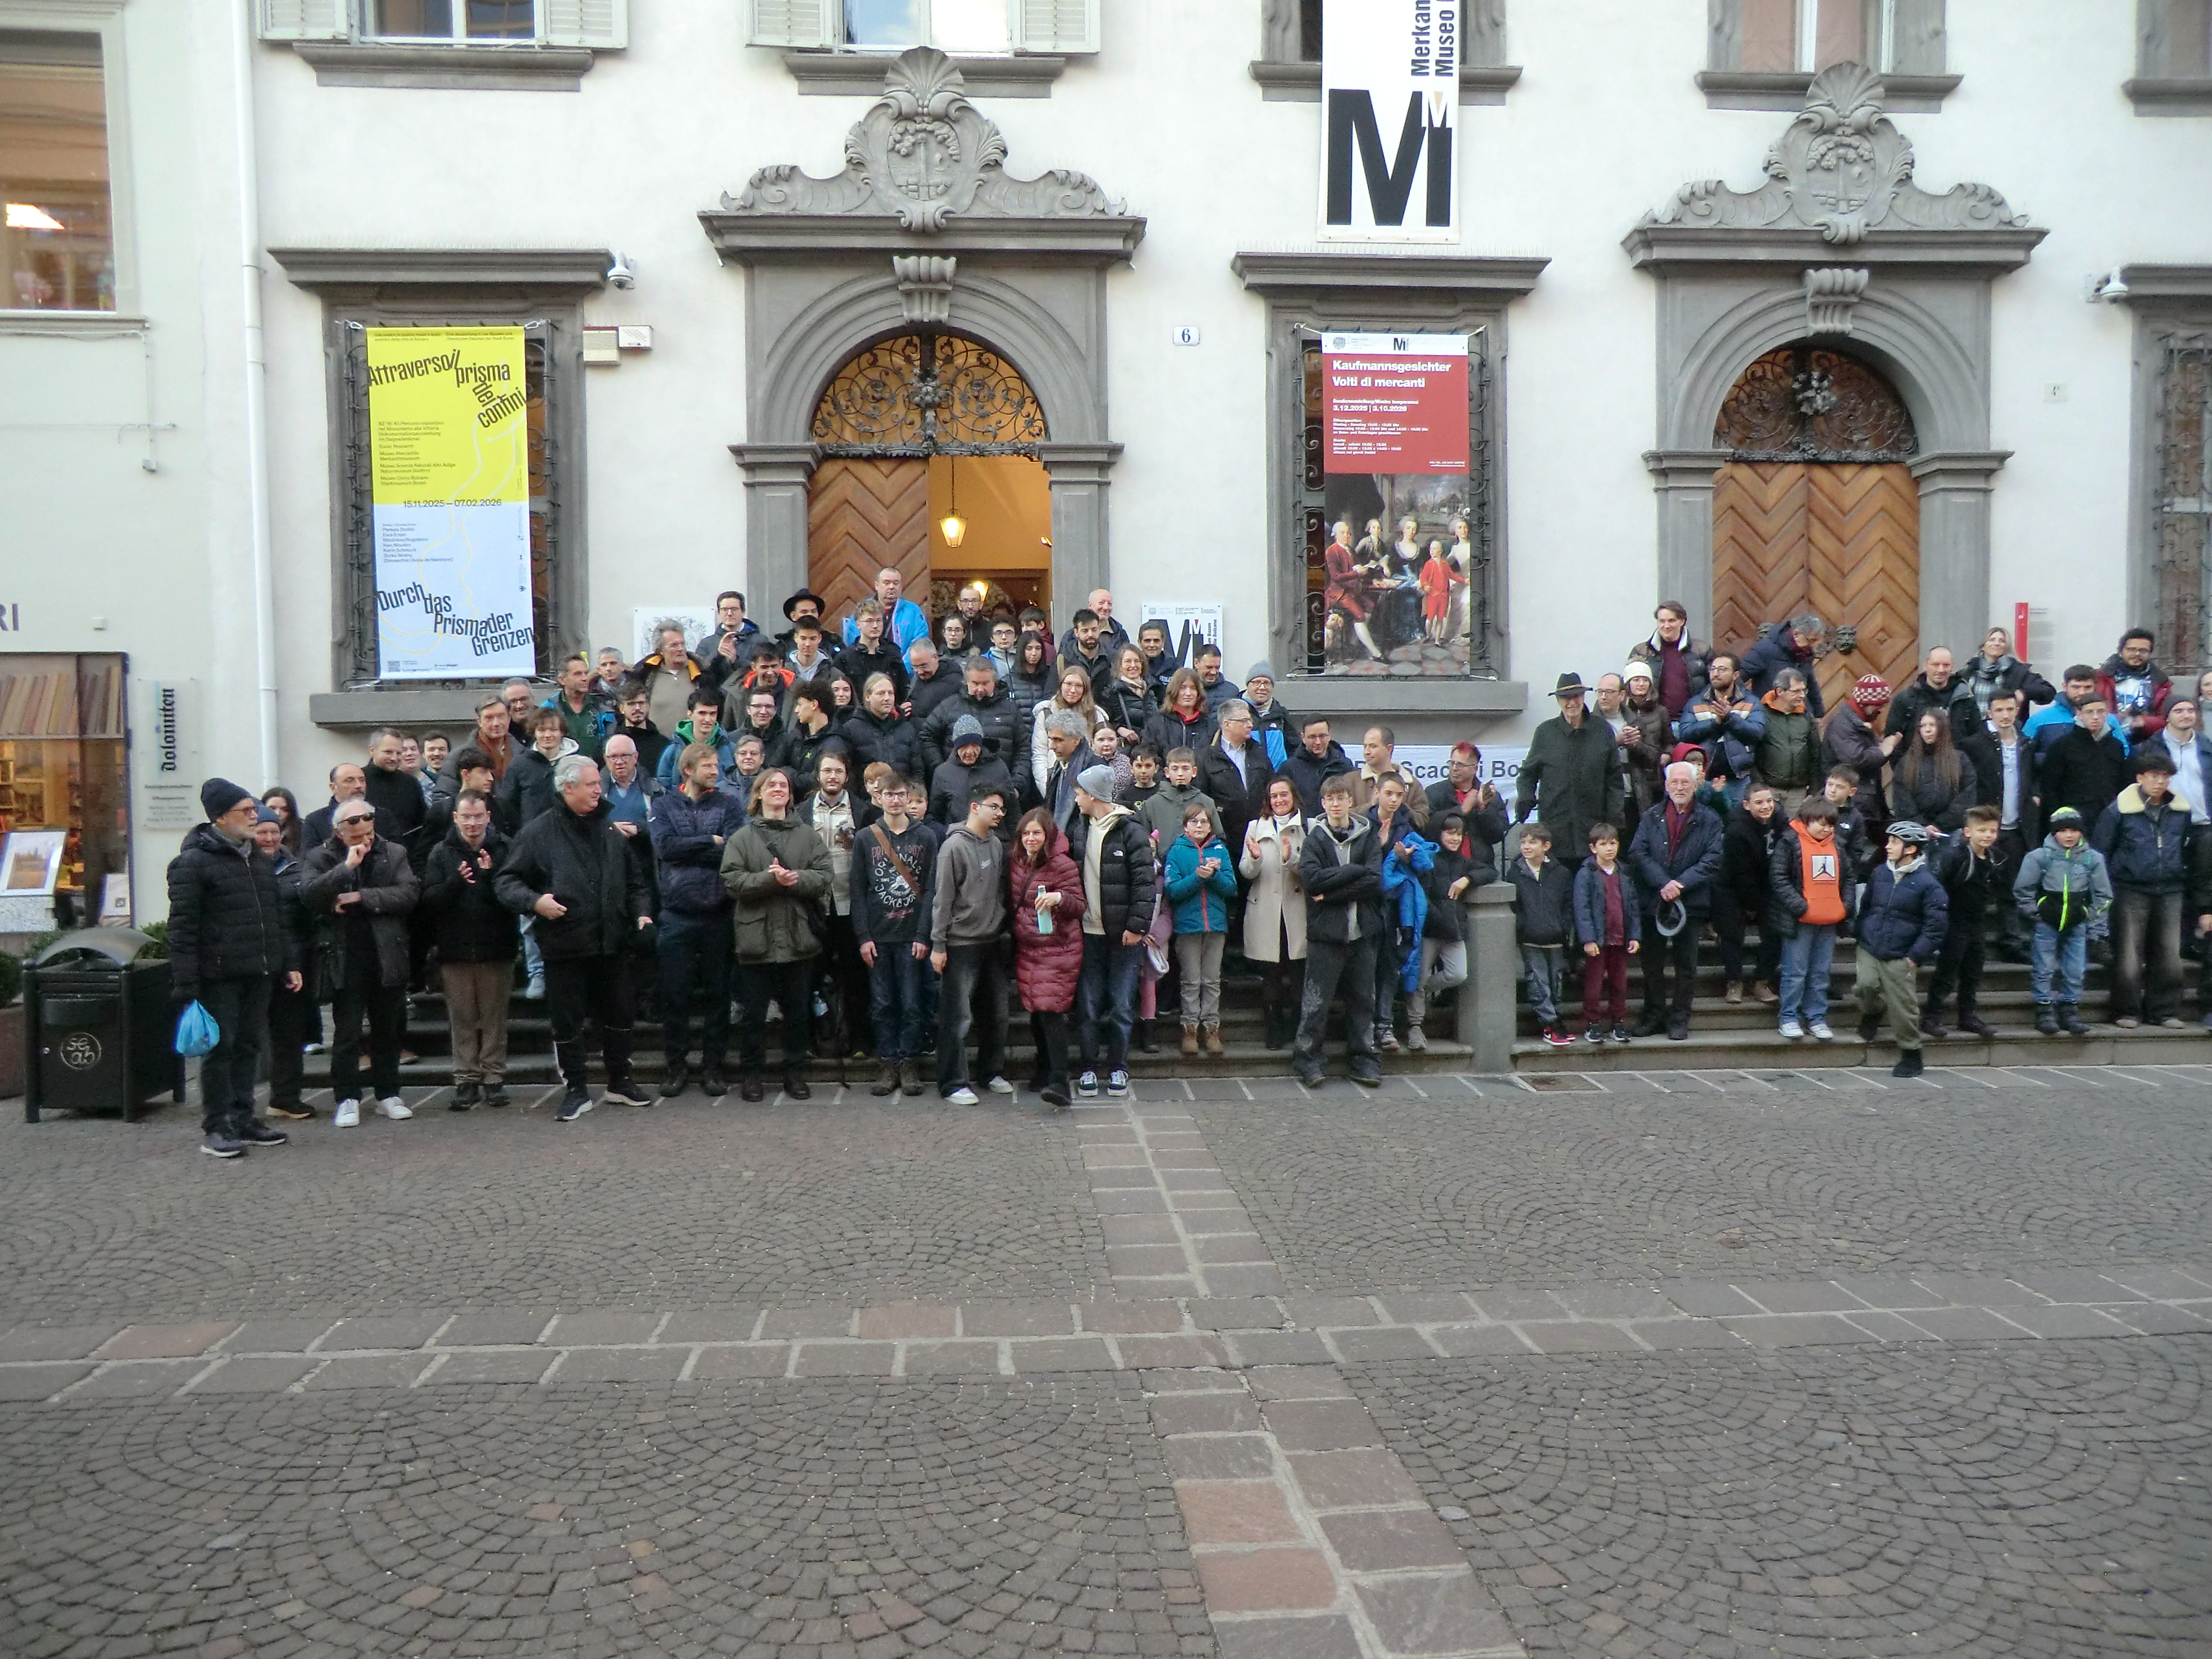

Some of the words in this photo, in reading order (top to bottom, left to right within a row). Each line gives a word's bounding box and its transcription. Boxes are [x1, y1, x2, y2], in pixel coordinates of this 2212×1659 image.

[1411, 0, 1430, 76] Merkan
[1435, 10, 1454, 77] Museo
[1182, 328, 1191, 343] 6
[368, 354, 451, 387] Attraverso
[448, 349, 461, 370] il
[1332, 359, 1452, 374] Kaufmannsgesichter
[455, 363, 510, 388] prisma
[1332, 376, 1358, 387] Volti
[1360, 377, 1371, 387] di
[1374, 377, 1426, 388] mercanti
[477, 387, 526, 428] confini
[455, 499, 502, 507] 07.02.2026
[378, 582, 425, 612] Durch
[424, 593, 452, 614] das
[434, 612, 487, 637] Prisma
[486, 613, 514, 634] der
[472, 627, 534, 657] Grenzen
[159, 688, 177, 773] Dolomiten
[1401, 760, 1483, 779] Scaci
